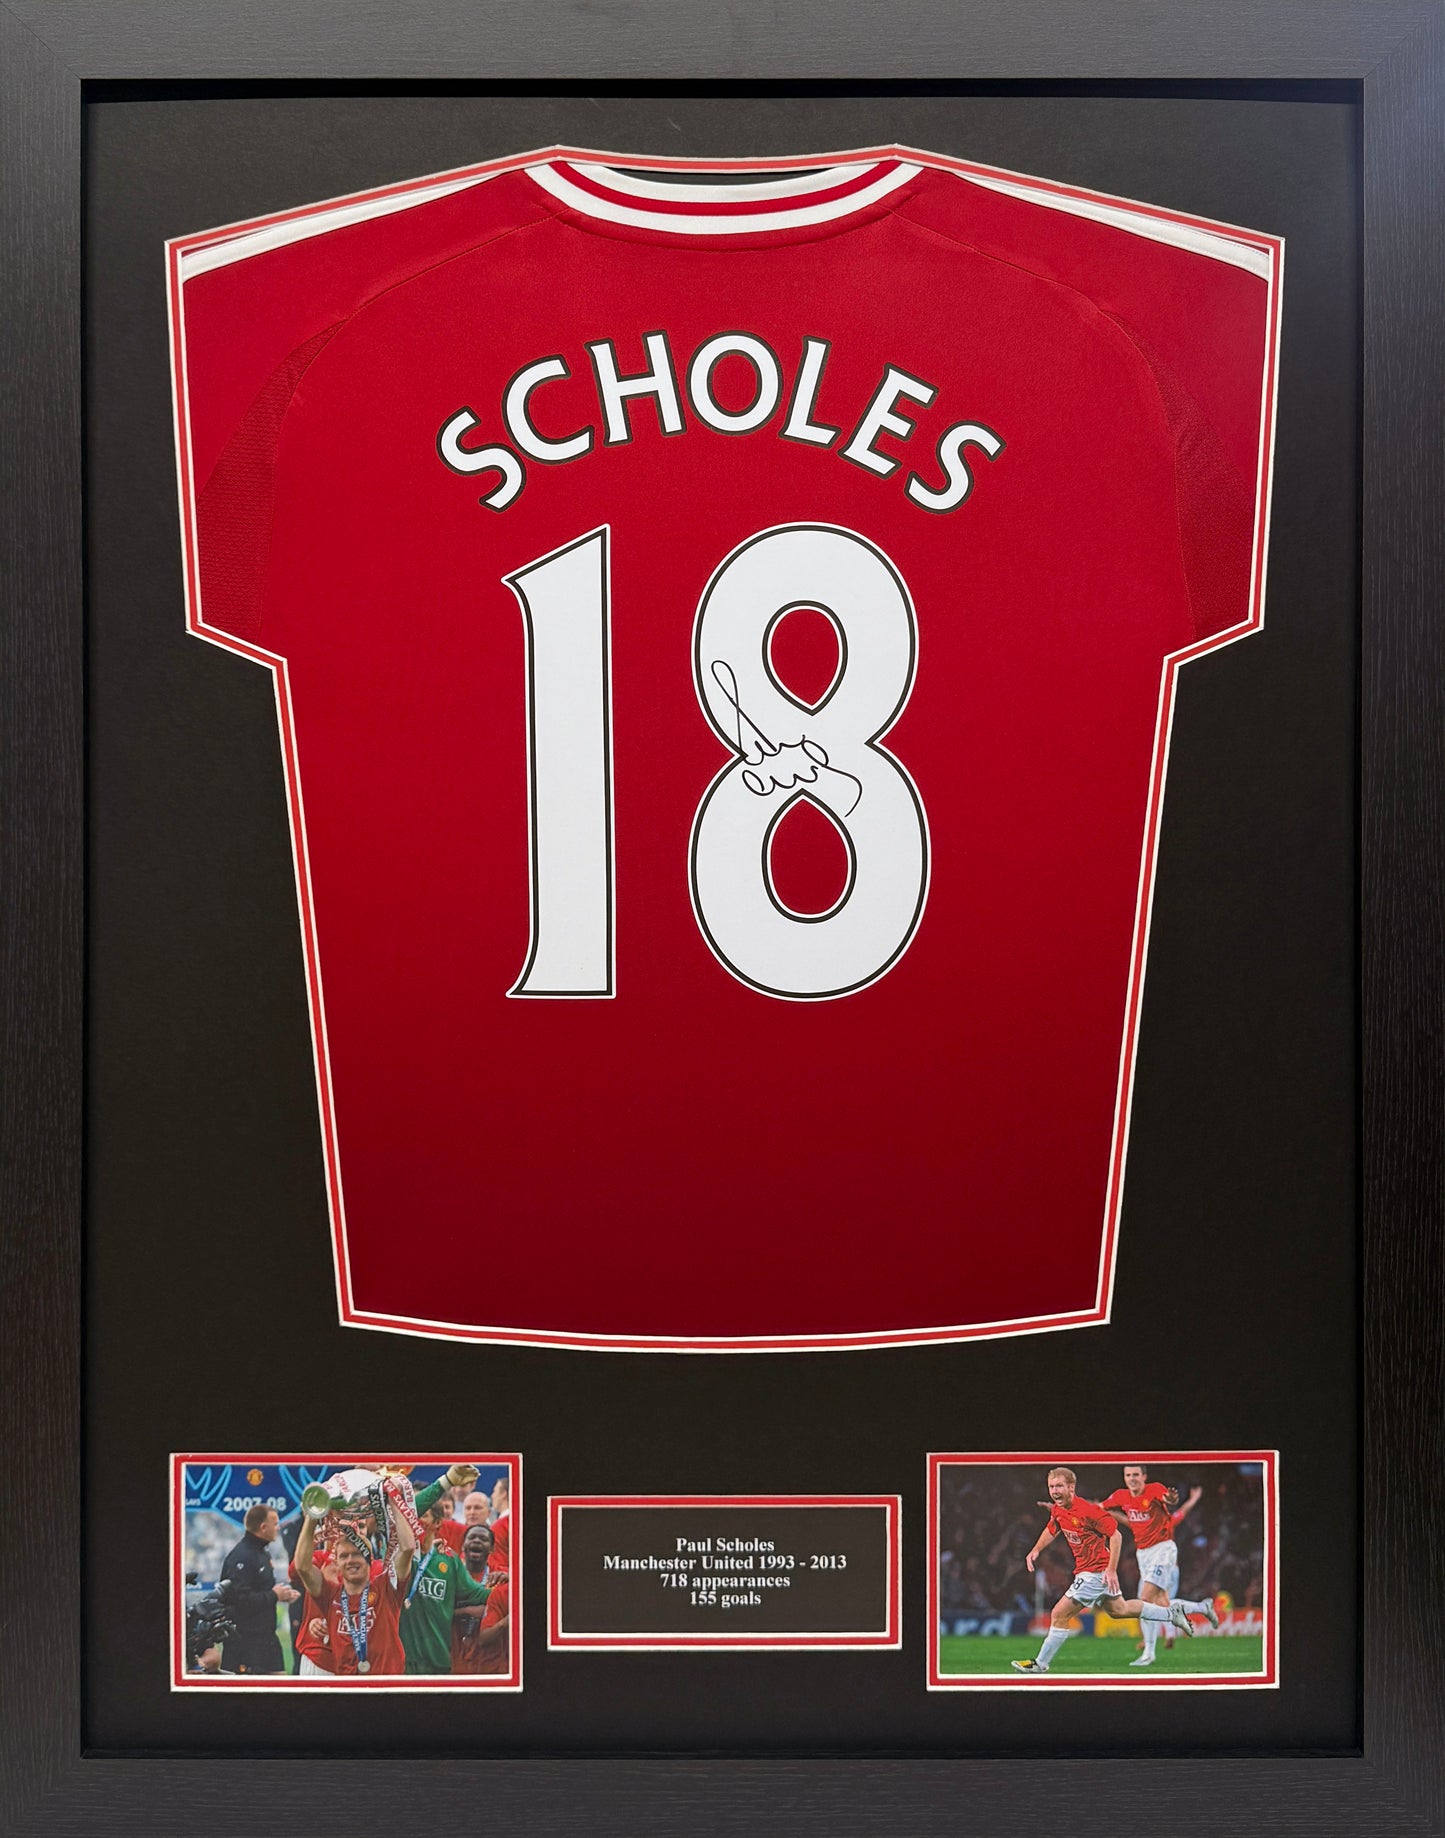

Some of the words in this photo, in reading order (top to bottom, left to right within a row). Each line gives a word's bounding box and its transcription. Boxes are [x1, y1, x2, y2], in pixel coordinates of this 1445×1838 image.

[437, 329, 1006, 513] SCHOLES
[501, 521, 931, 1002] 18
[393, 1494, 425, 1536] BARCLAYS
[676, 1538, 712, 1551] Paul
[716, 1538, 775, 1551] Scholes
[603, 1556, 697, 1569] Manchester
[702, 1555, 754, 1569] United
[759, 1555, 795, 1569] 1993
[810, 1555, 847, 1569] 2013
[419, 1579, 445, 1599] AIG
[660, 1573, 688, 1588] 718
[692, 1575, 791, 1591] appearances
[690, 1591, 717, 1605] 155
[721, 1591, 762, 1608] goals
